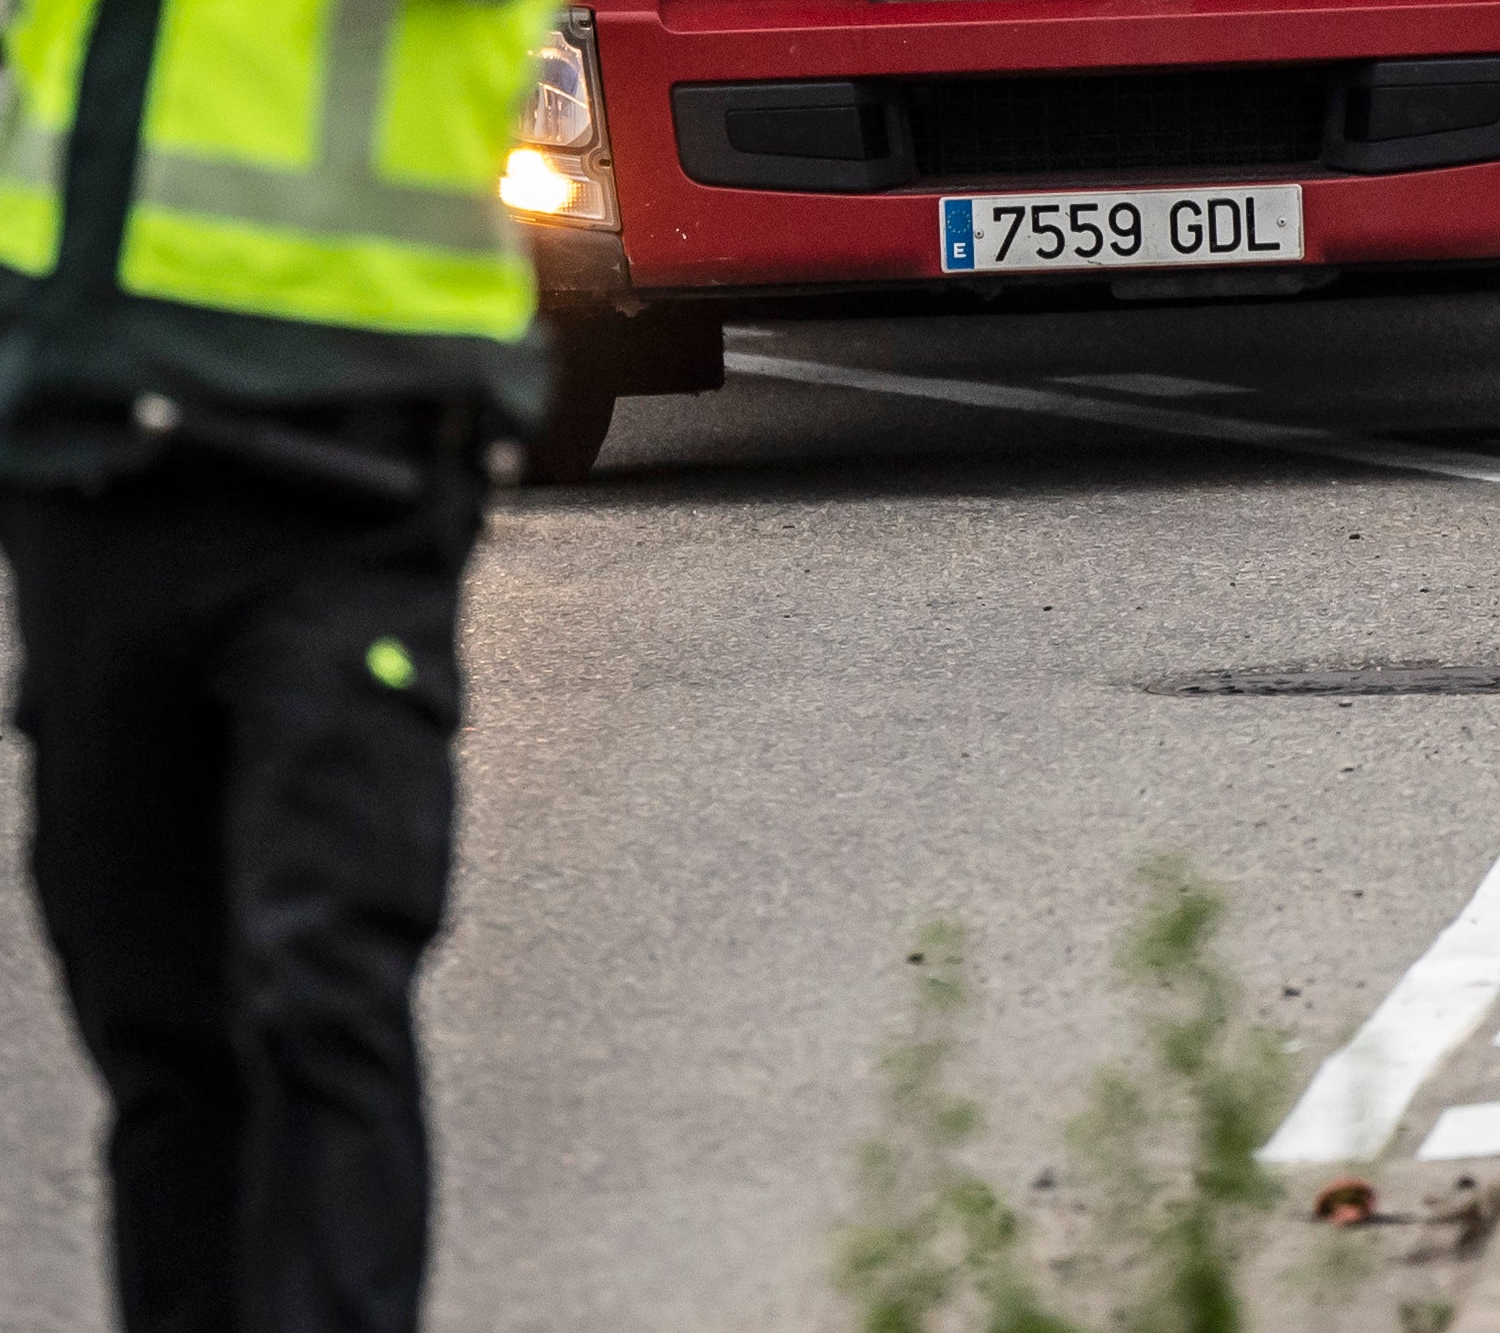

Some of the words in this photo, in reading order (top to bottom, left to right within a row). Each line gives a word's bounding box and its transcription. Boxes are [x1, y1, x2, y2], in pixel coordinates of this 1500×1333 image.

[953, 242, 967, 259] E
[992, 201, 1142, 263] 7559
[1169, 196, 1281, 255] GDL
